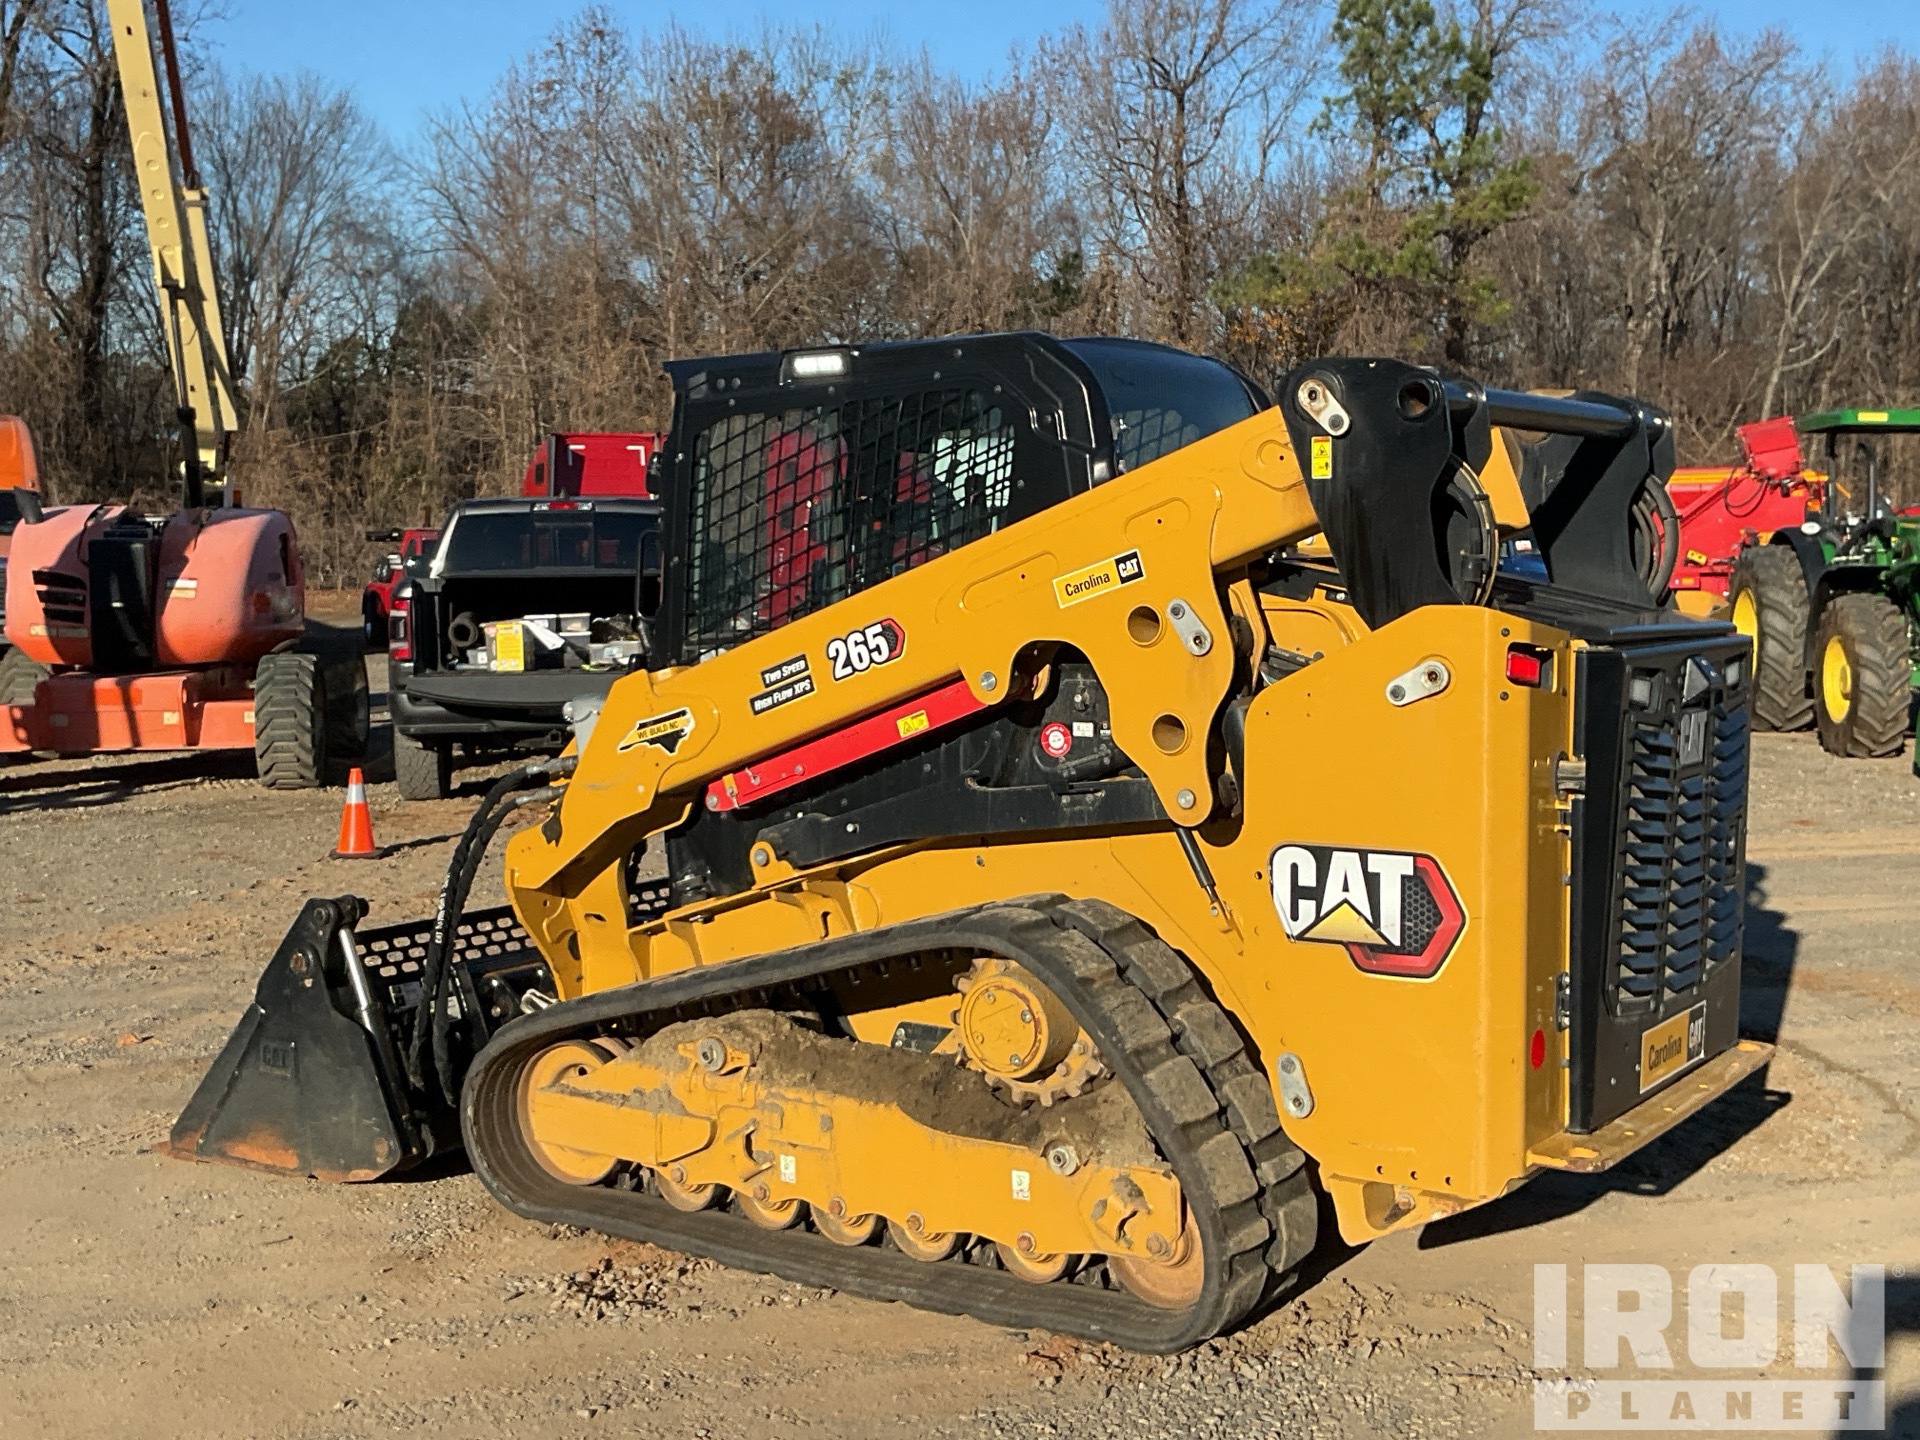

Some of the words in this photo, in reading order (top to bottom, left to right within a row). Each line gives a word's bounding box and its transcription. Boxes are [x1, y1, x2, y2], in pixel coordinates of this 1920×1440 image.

[1064, 573, 1111, 597] Carolina
[1118, 558, 1139, 578] CAT
[827, 622, 890, 679] 265
[793, 679, 811, 695] XPS
[636, 730, 648, 739] WE
[649, 723, 669, 736] BUILD
[669, 720, 679, 730] NC
[1272, 846, 1414, 947] CAT
[1648, 1034, 1682, 1071] Carolina
